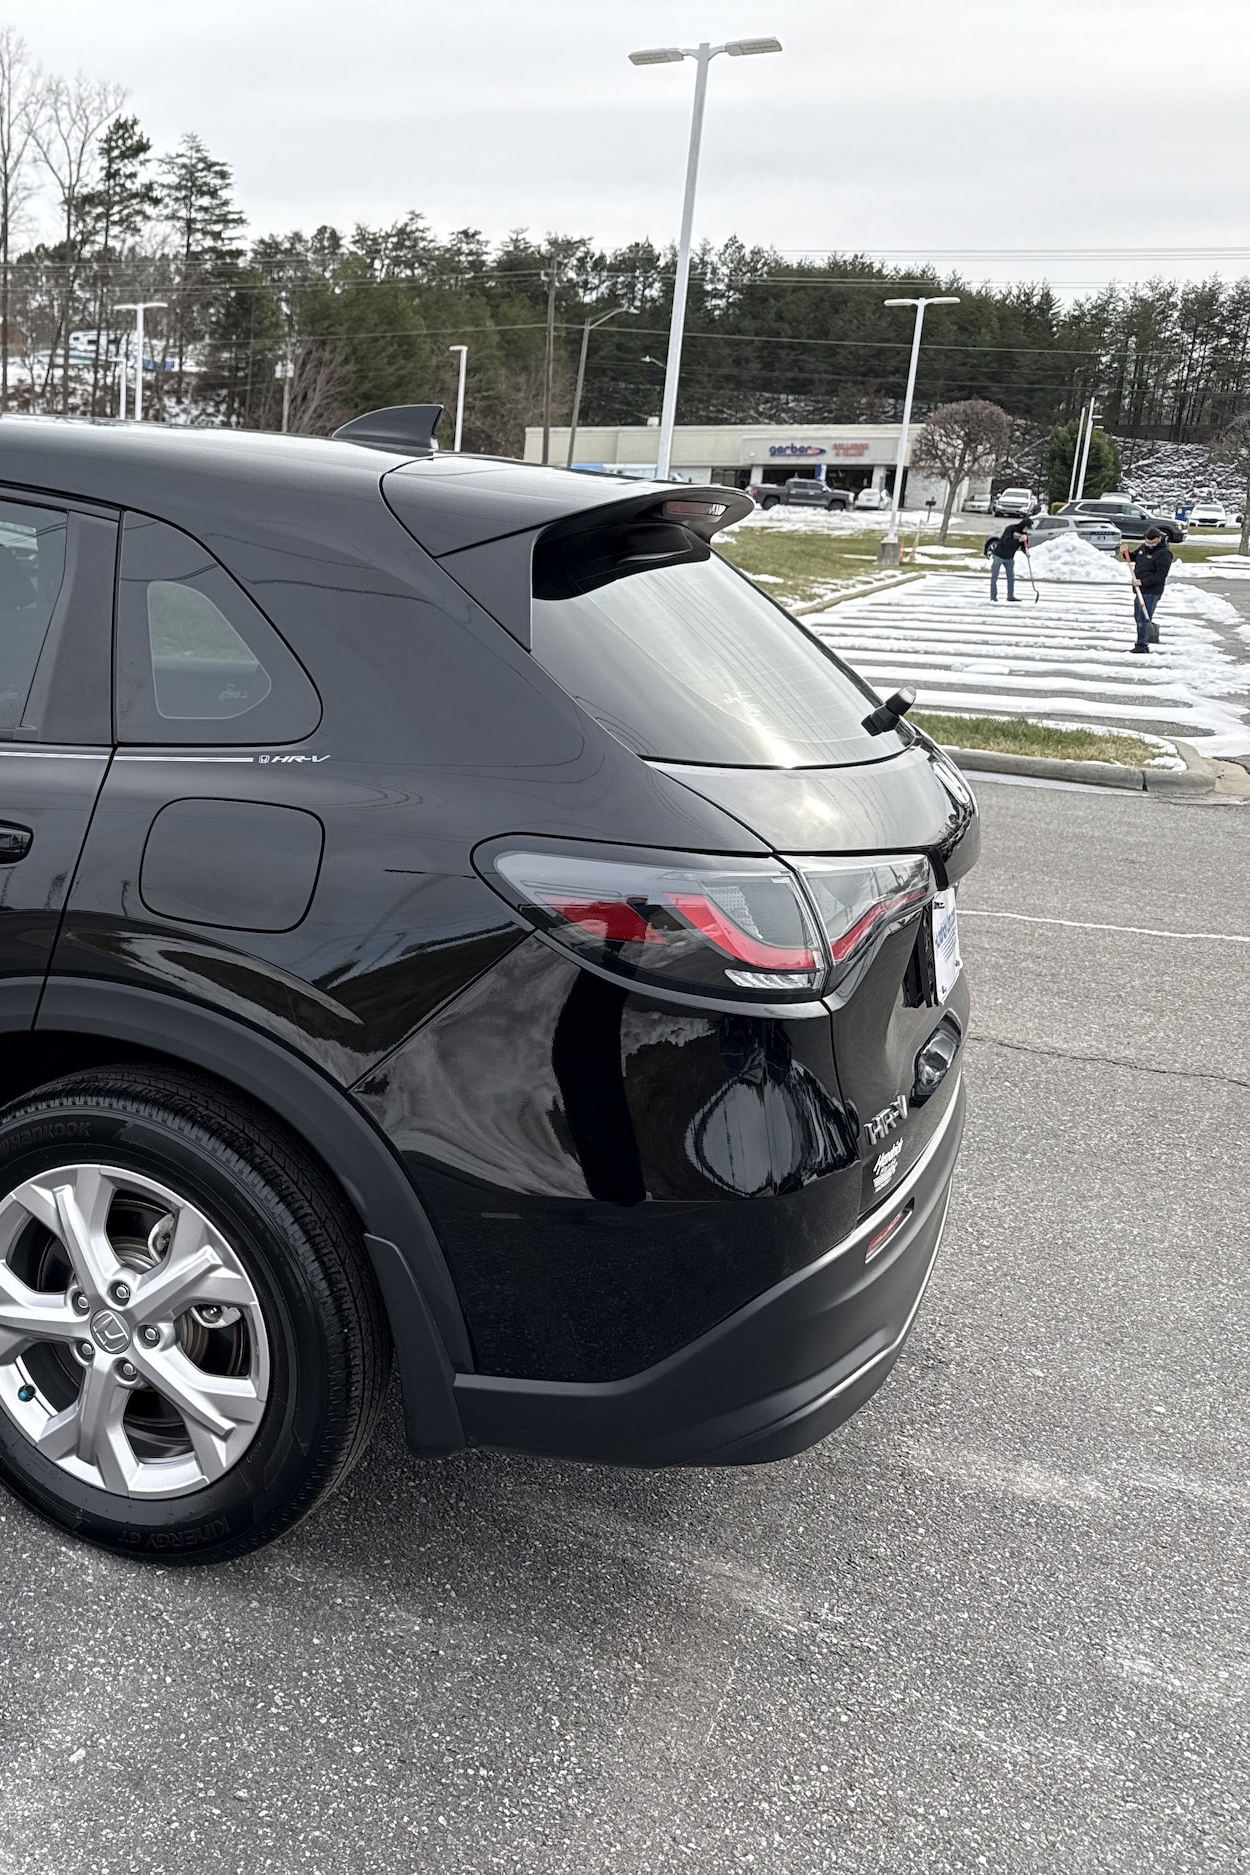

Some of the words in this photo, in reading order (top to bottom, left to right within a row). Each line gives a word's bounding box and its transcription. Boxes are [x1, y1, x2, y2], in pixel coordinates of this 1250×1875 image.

[769, 443, 811, 457] gerber
[271, 755, 331, 763] HR-V
[863, 1094, 908, 1146] HR-V
